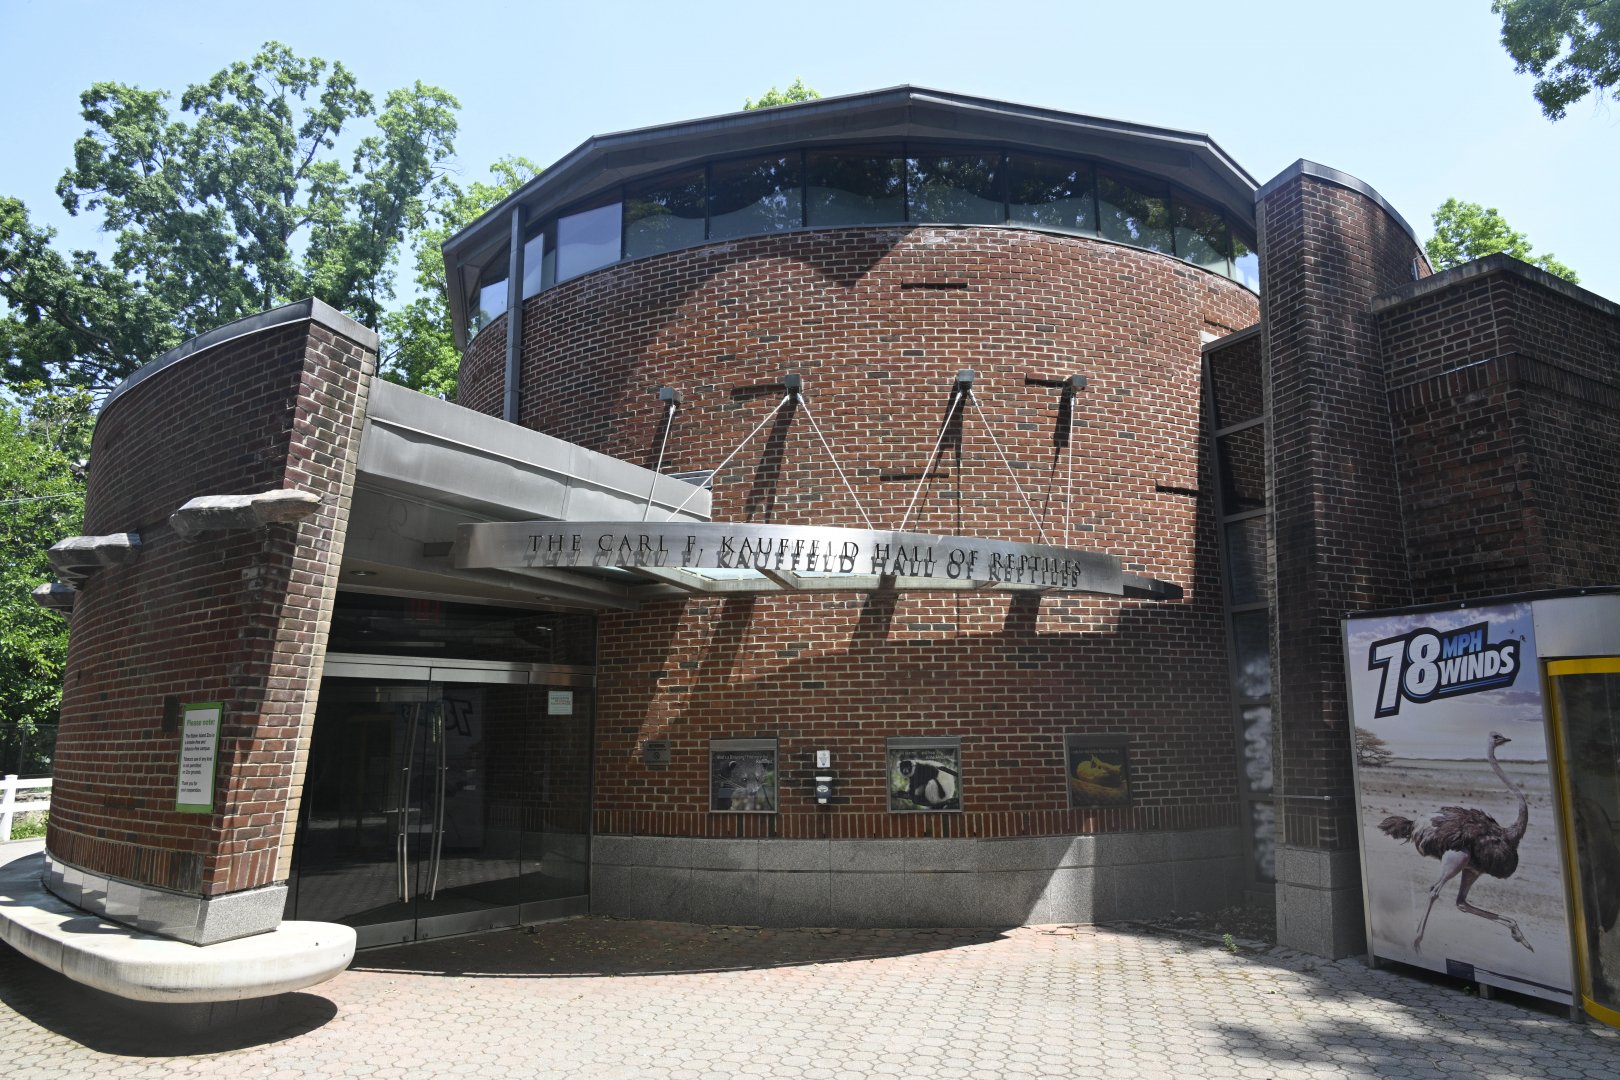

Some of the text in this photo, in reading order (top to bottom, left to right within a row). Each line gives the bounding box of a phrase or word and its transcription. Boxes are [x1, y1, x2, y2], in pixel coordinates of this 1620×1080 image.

[528, 534, 582, 552] THE
[597, 534, 669, 552] CARL
[874, 543, 938, 563] HALL
[949, 548, 979, 567] OF
[990, 551, 1081, 576] REPTILES
[1373, 629, 1483, 712] 78 MPH
[1438, 645, 1515, 686] WINDS
